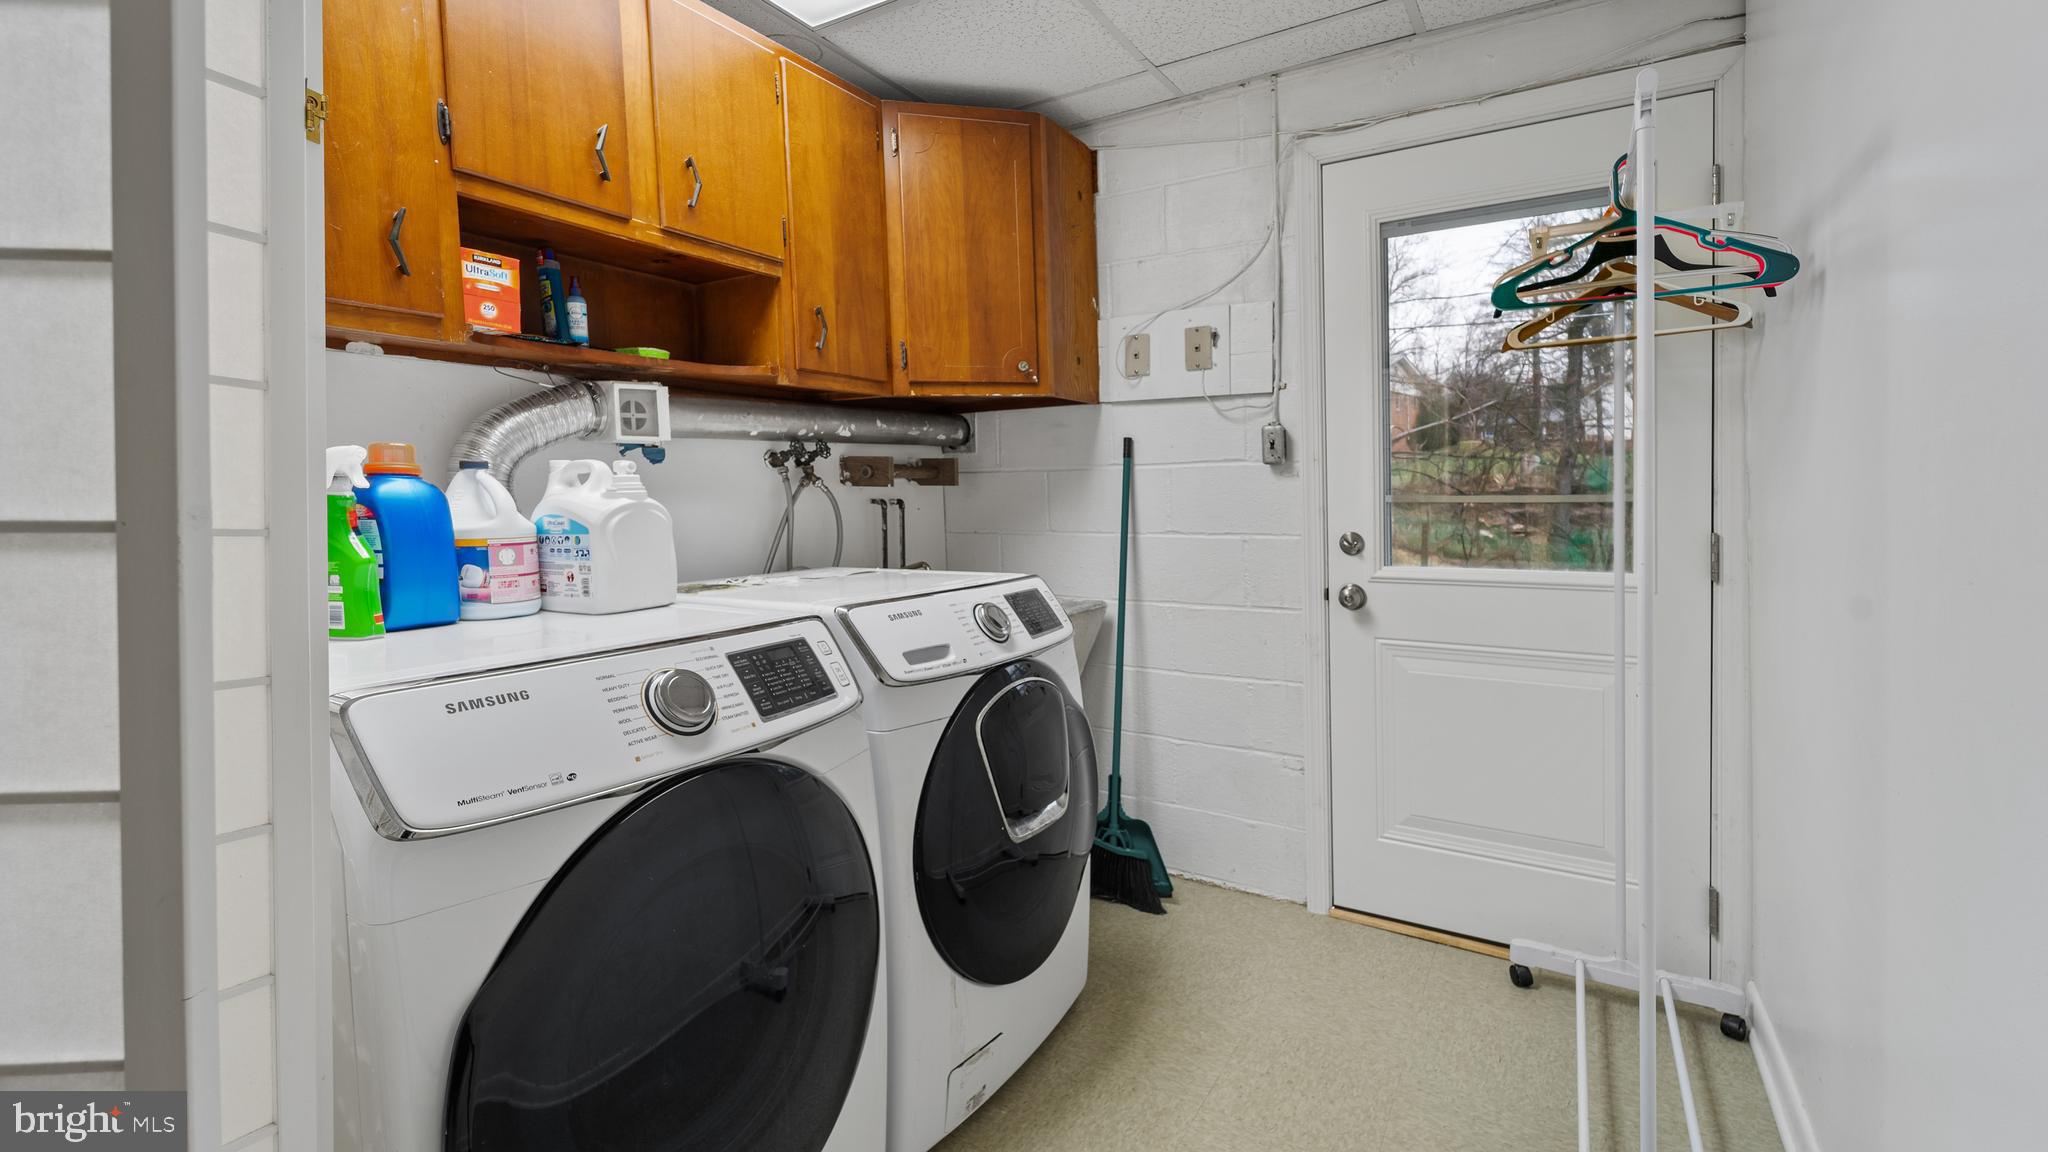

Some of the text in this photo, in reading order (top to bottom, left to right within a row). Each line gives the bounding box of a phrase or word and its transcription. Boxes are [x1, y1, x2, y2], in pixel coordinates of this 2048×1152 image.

[465, 264, 508, 279] UltraSoft
[483, 303, 495, 312] 250
[887, 609, 923, 622] SAMSUNG
[445, 690, 530, 715] SAMSUNG
[607, 695, 629, 703] BEDDING
[622, 726, 647, 736] DELICATES
[627, 734, 658, 747] ACTIVE WEAR
[507, 781, 548, 796] VentSensor
